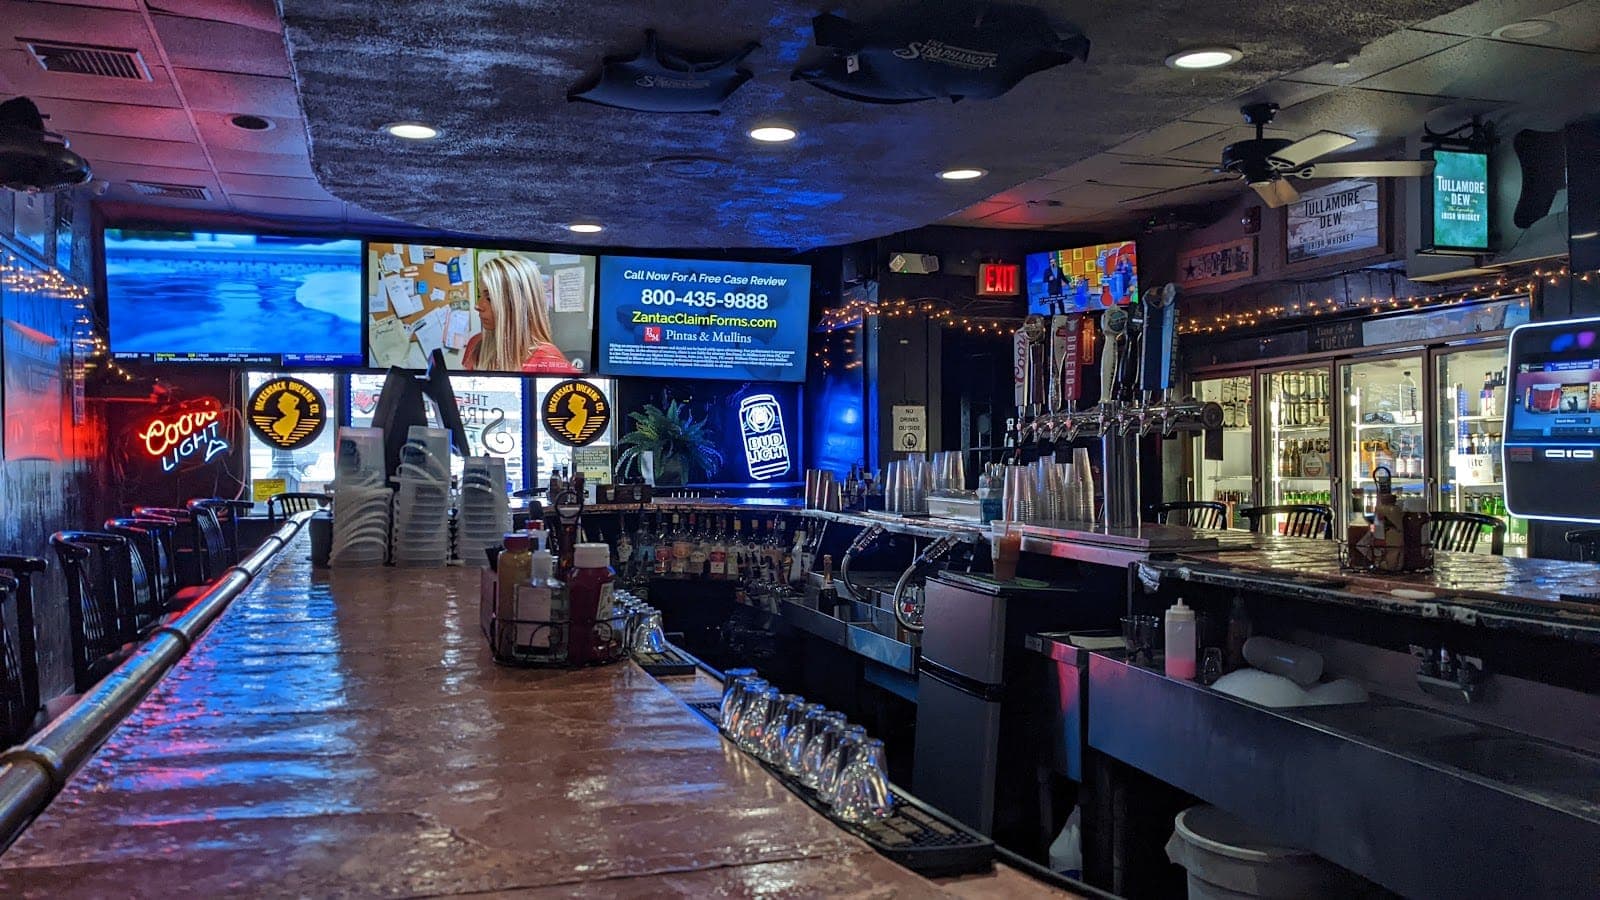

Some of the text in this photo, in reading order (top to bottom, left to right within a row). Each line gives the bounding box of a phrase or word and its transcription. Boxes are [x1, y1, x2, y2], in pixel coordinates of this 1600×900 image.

[1435, 175, 1486, 194] TULLAMORE
[1305, 190, 1360, 216] TULLAMORE
[1451, 193, 1471, 206] DEW
[1320, 213, 1342, 229] DEW
[1441, 212, 1480, 222] IRISH WHISKEY
[1327, 233, 1355, 246] WHISKEY
[624, 270, 787, 287] Call Now For A Free Case Review
[985, 265, 1016, 293] EXIT
[641, 289, 768, 309] 800-435-9888
[632, 311, 777, 328] ZantacClaimForms.com
[666, 330, 697, 341] Pintas
[700, 332, 709, 341] &
[712, 332, 751, 343] Mullins
[1066, 335, 1077, 385] BOLERO
[139, 411, 217, 455] Coors
[748, 431, 783, 451] BUD
[162, 421, 219, 471] LIGHT
[748, 444, 787, 464] LIGHT
